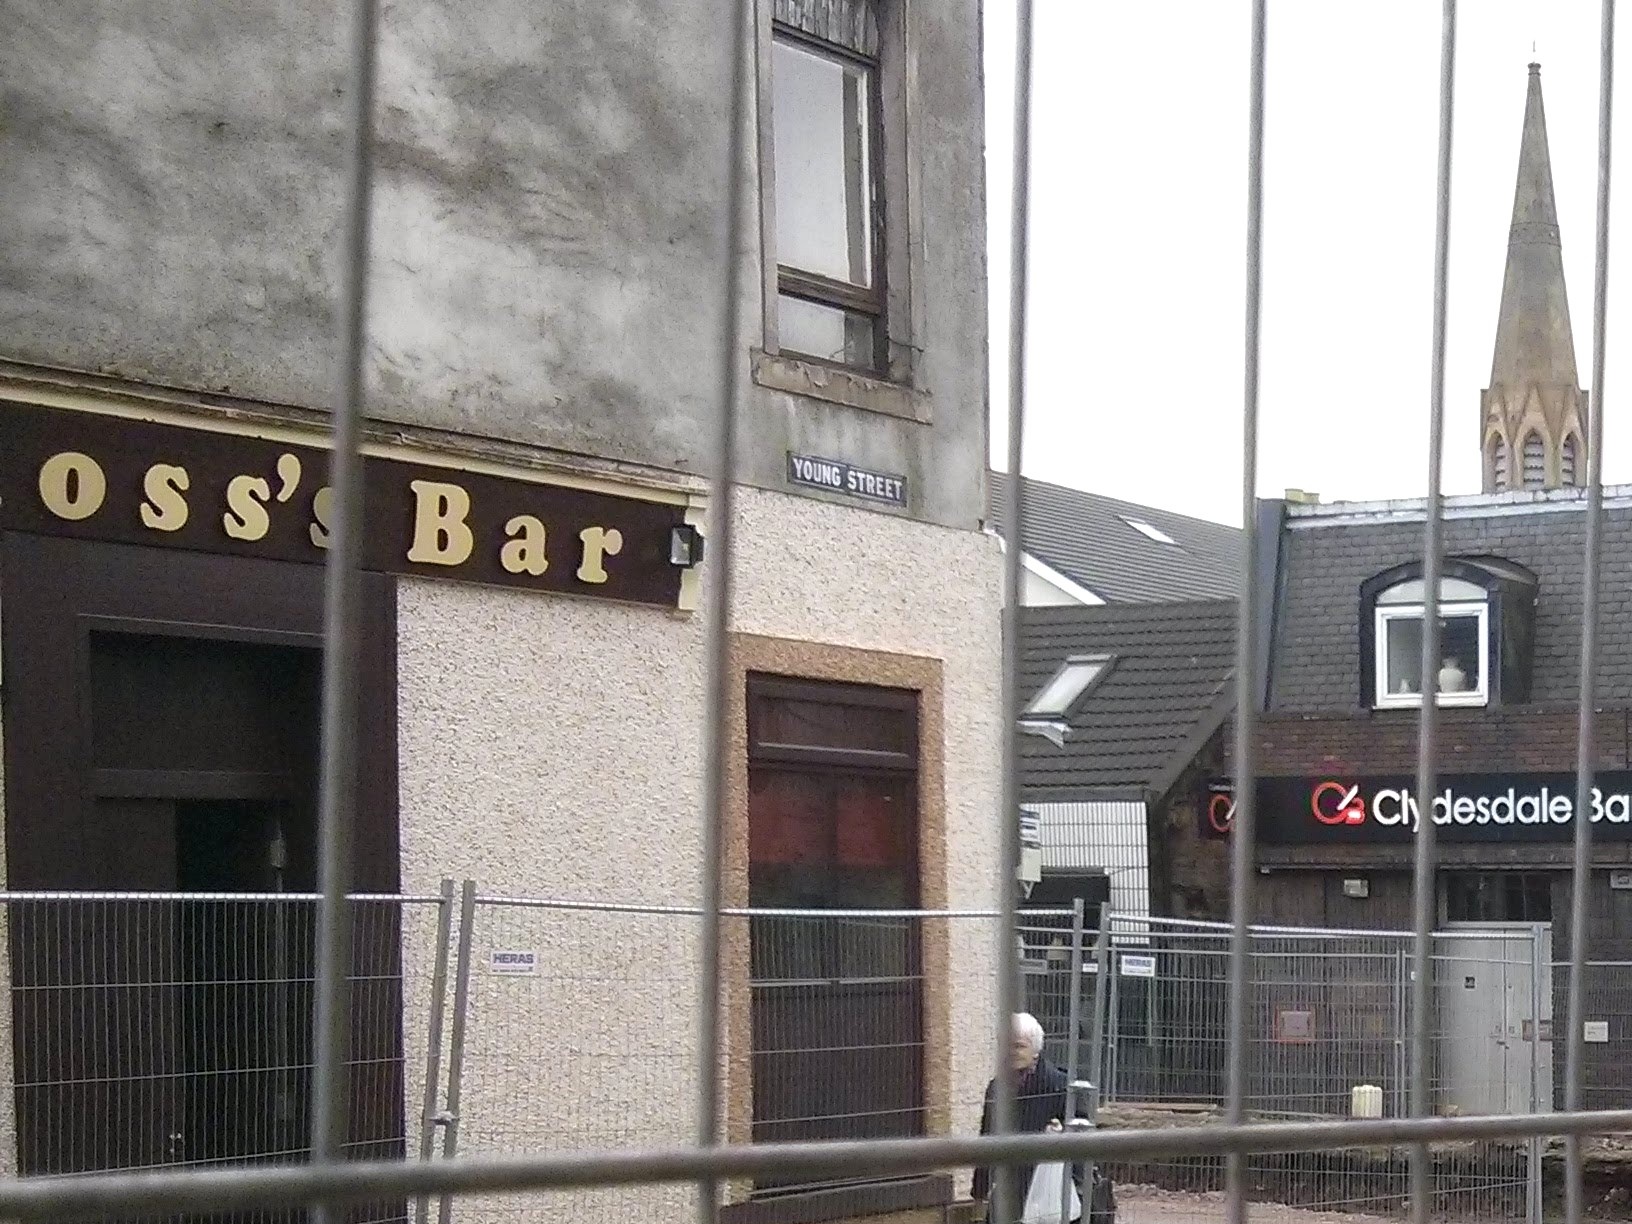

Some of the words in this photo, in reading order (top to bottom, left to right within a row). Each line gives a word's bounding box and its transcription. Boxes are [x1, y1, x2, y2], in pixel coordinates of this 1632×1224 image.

[793, 458, 840, 486] YOUNG
[847, 470, 902, 500] STREET
[408, 480, 623, 583] Bar
[1373, 787, 1573, 833] Clydesdale
[492, 953, 534, 964] HERAS
